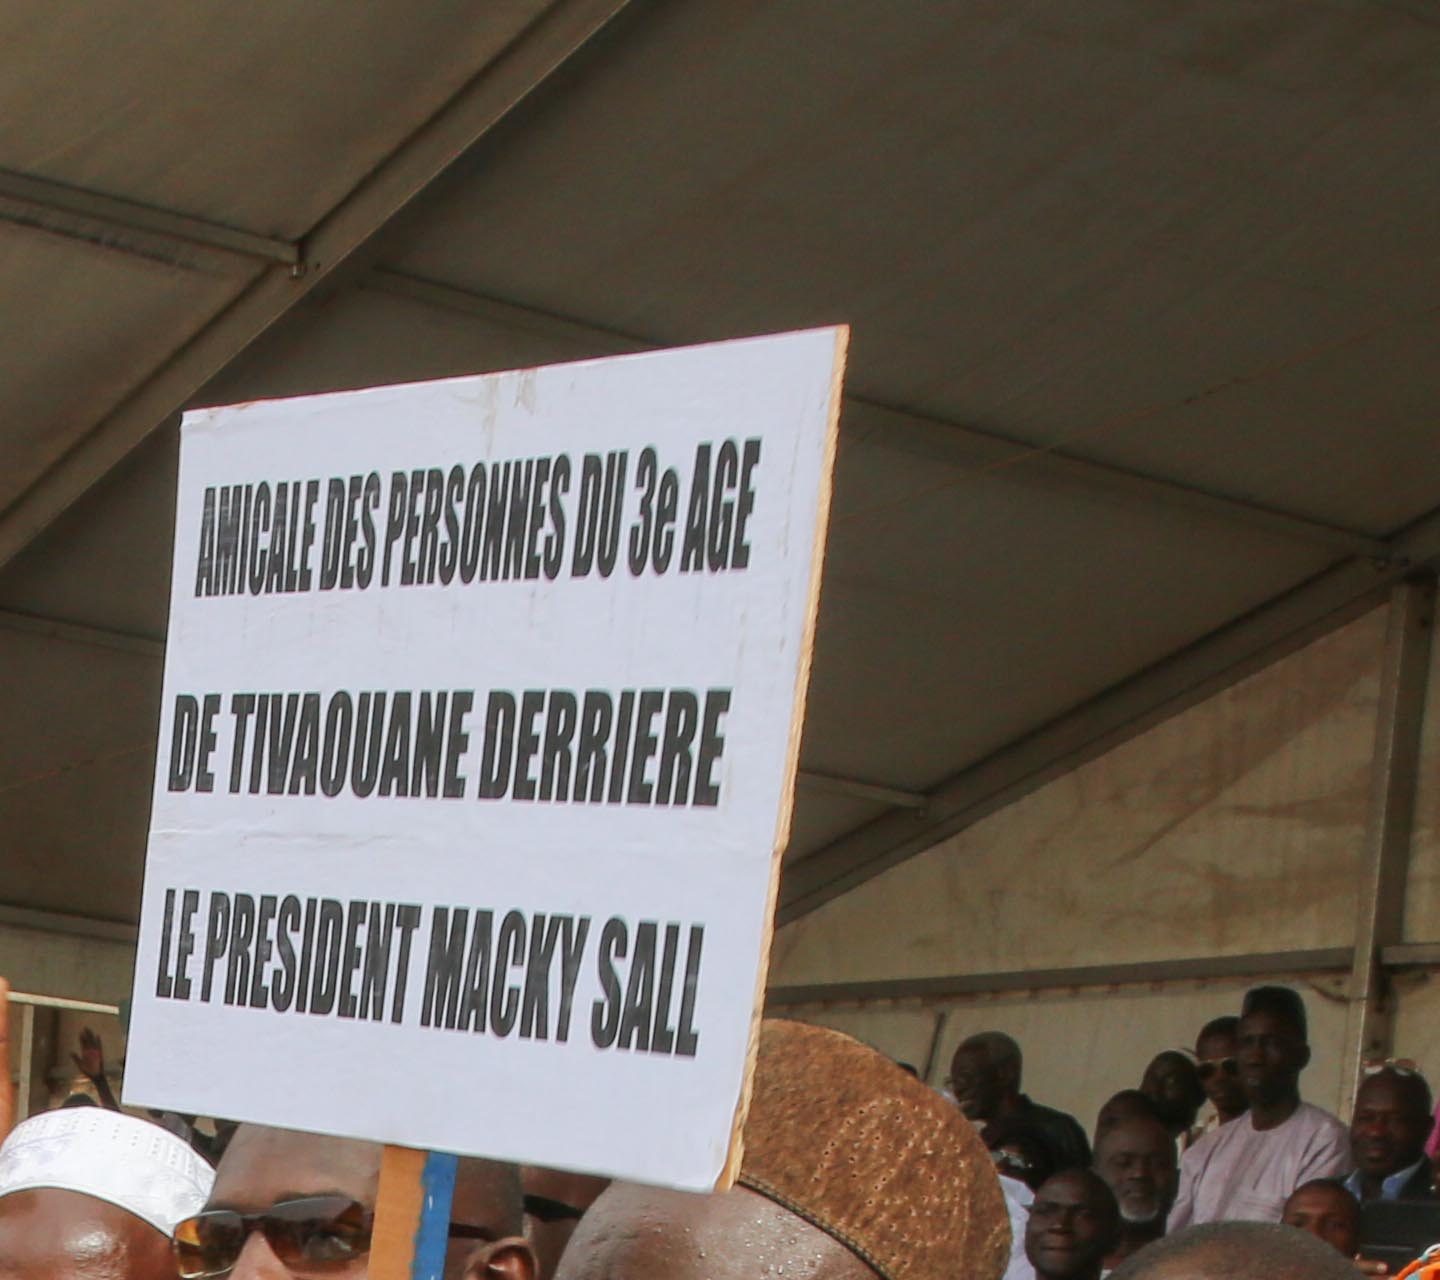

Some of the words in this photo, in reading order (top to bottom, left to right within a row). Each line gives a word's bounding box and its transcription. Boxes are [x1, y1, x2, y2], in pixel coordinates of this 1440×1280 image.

[195, 478, 319, 597] AMICALE
[319, 472, 381, 591] DES
[381, 454, 572, 586] PERSONNES
[571, 448, 631, 578] DU
[629, 446, 679, 575] 3e
[680, 437, 762, 574] AGE
[167, 693, 220, 794] DE
[229, 690, 474, 799] TIVAOUANE
[478, 688, 732, 808] DERRIERE
[155, 888, 200, 1000] LE
[200, 893, 422, 1025] PRESIDENT
[420, 906, 591, 1044] MACKY
[590, 916, 705, 1059] SALL
